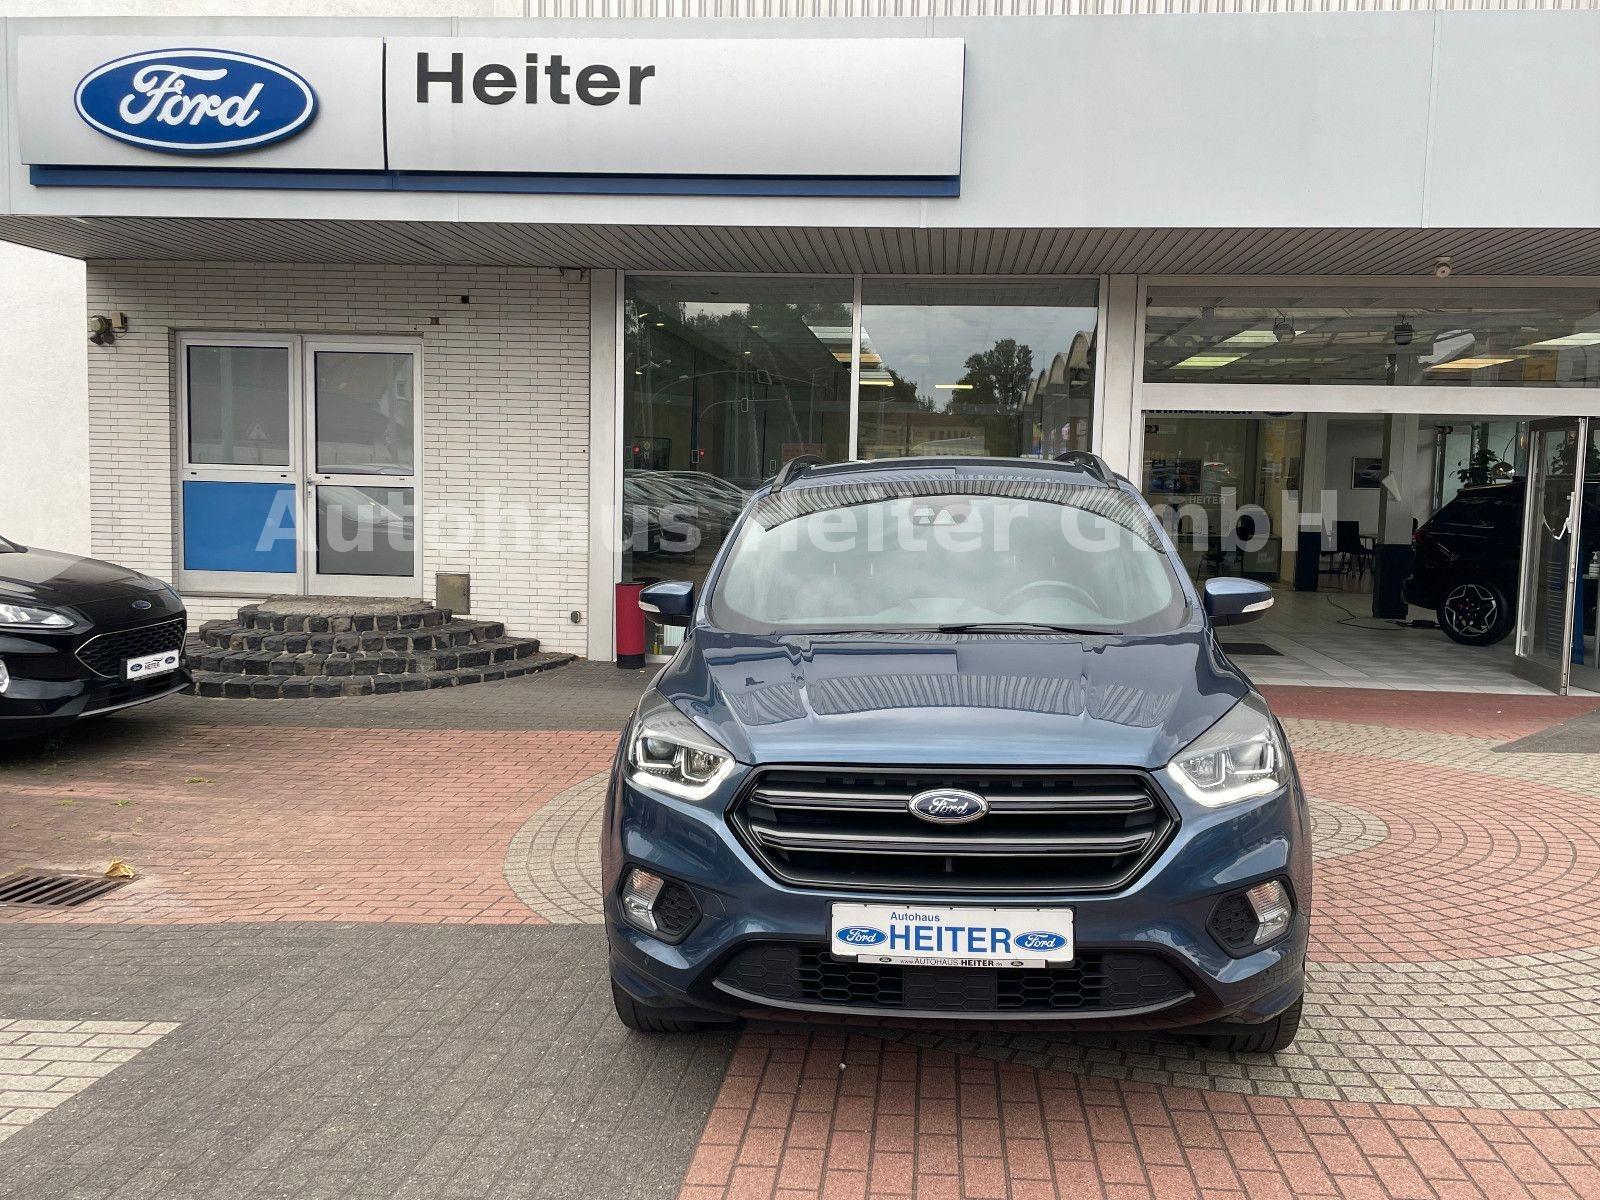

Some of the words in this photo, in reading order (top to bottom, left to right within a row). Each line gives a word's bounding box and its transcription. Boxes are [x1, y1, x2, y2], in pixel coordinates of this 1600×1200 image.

[416, 52, 655, 105] Heiter
[119, 64, 262, 128] Ford
[1189, 495, 1226, 504] HEITER
[928, 797, 969, 815] Ford
[890, 911, 941, 922] Autohaus
[846, 929, 877, 943] Ford
[889, 924, 1012, 954] HEITER
[1024, 934, 1056, 949] Ford
